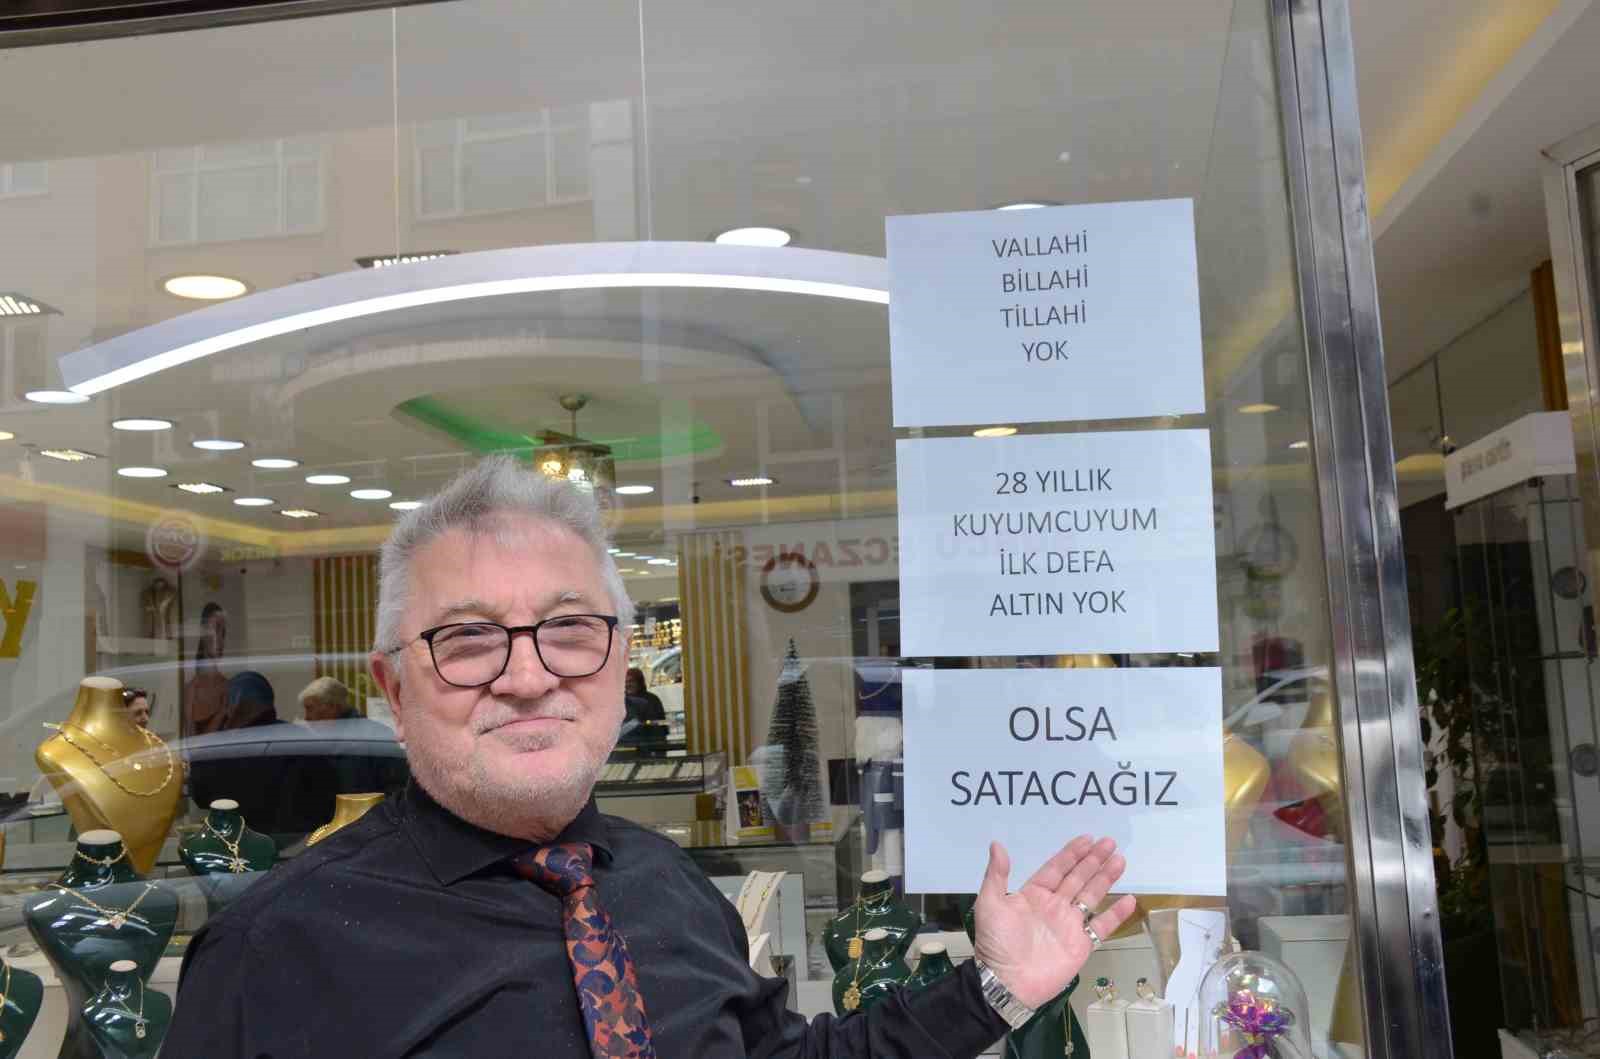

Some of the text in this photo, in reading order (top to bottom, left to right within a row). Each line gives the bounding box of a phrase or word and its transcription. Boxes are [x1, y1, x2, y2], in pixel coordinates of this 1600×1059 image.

[991, 229, 1088, 259] VALLAHİ
[1002, 264, 1088, 293] BİLLAHİ
[1000, 300, 1086, 329] TİLLAHİ
[1022, 340, 1069, 362] YOK
[996, 468, 1113, 496] 28 YILLIK
[953, 507, 1157, 537] KUYUMCUYUM
[1000, 548, 1115, 576] İLK DEFA
[990, 590, 1127, 617] ALTIN YOK
[1009, 706, 1118, 742] OLSA
[951, 761, 1179, 807] SATACAĞIZ
